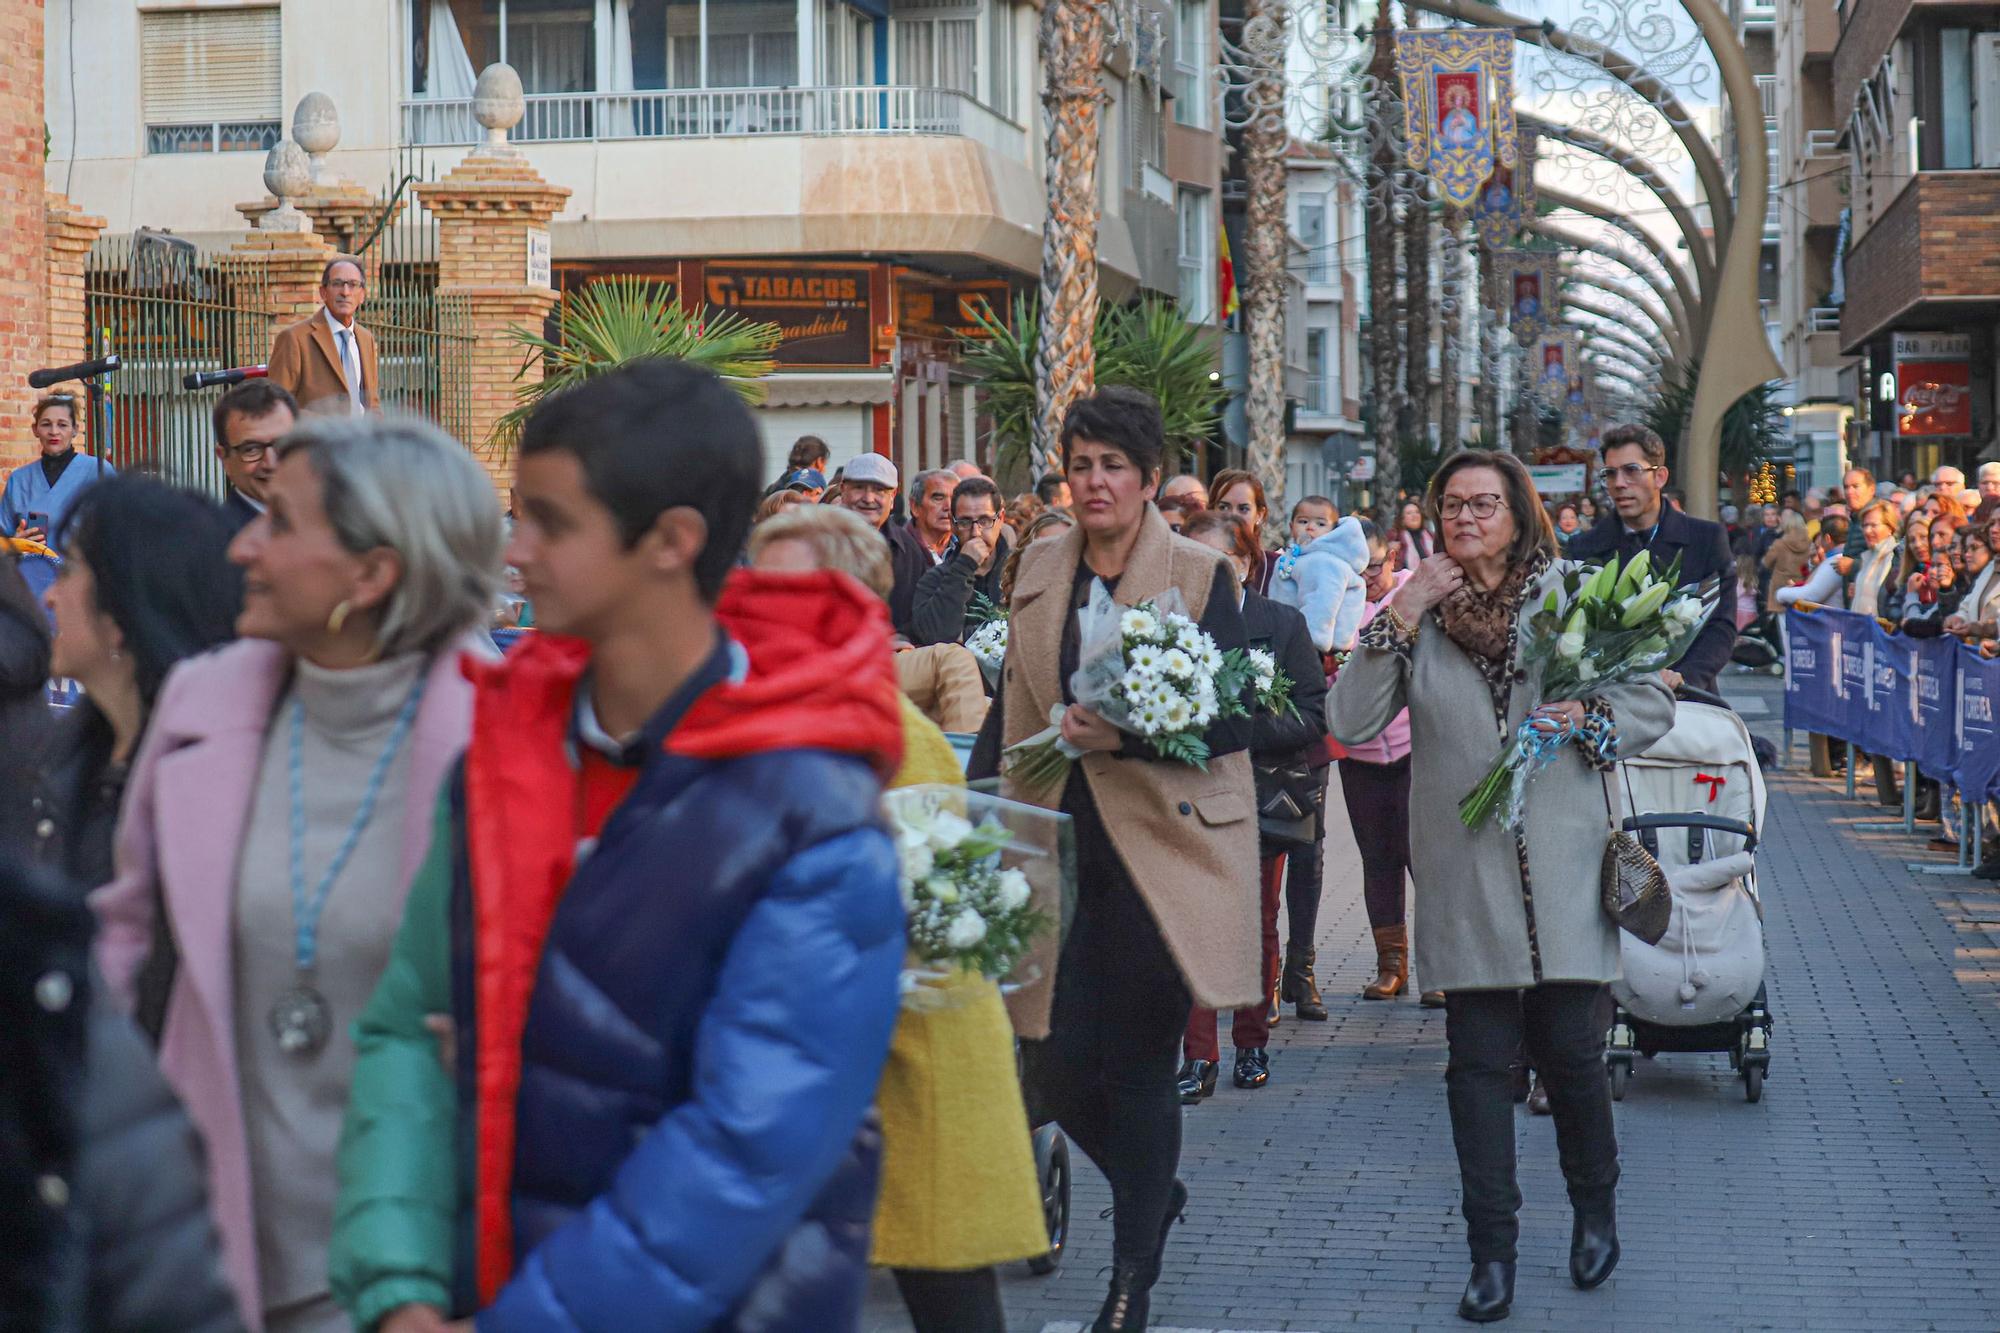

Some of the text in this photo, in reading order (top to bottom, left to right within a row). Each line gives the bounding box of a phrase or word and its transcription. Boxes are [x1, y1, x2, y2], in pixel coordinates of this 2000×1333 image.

[743, 276, 856, 299] TABACOS
[769, 311, 848, 345] uardiola
[1897, 341, 1921, 353] BAR
